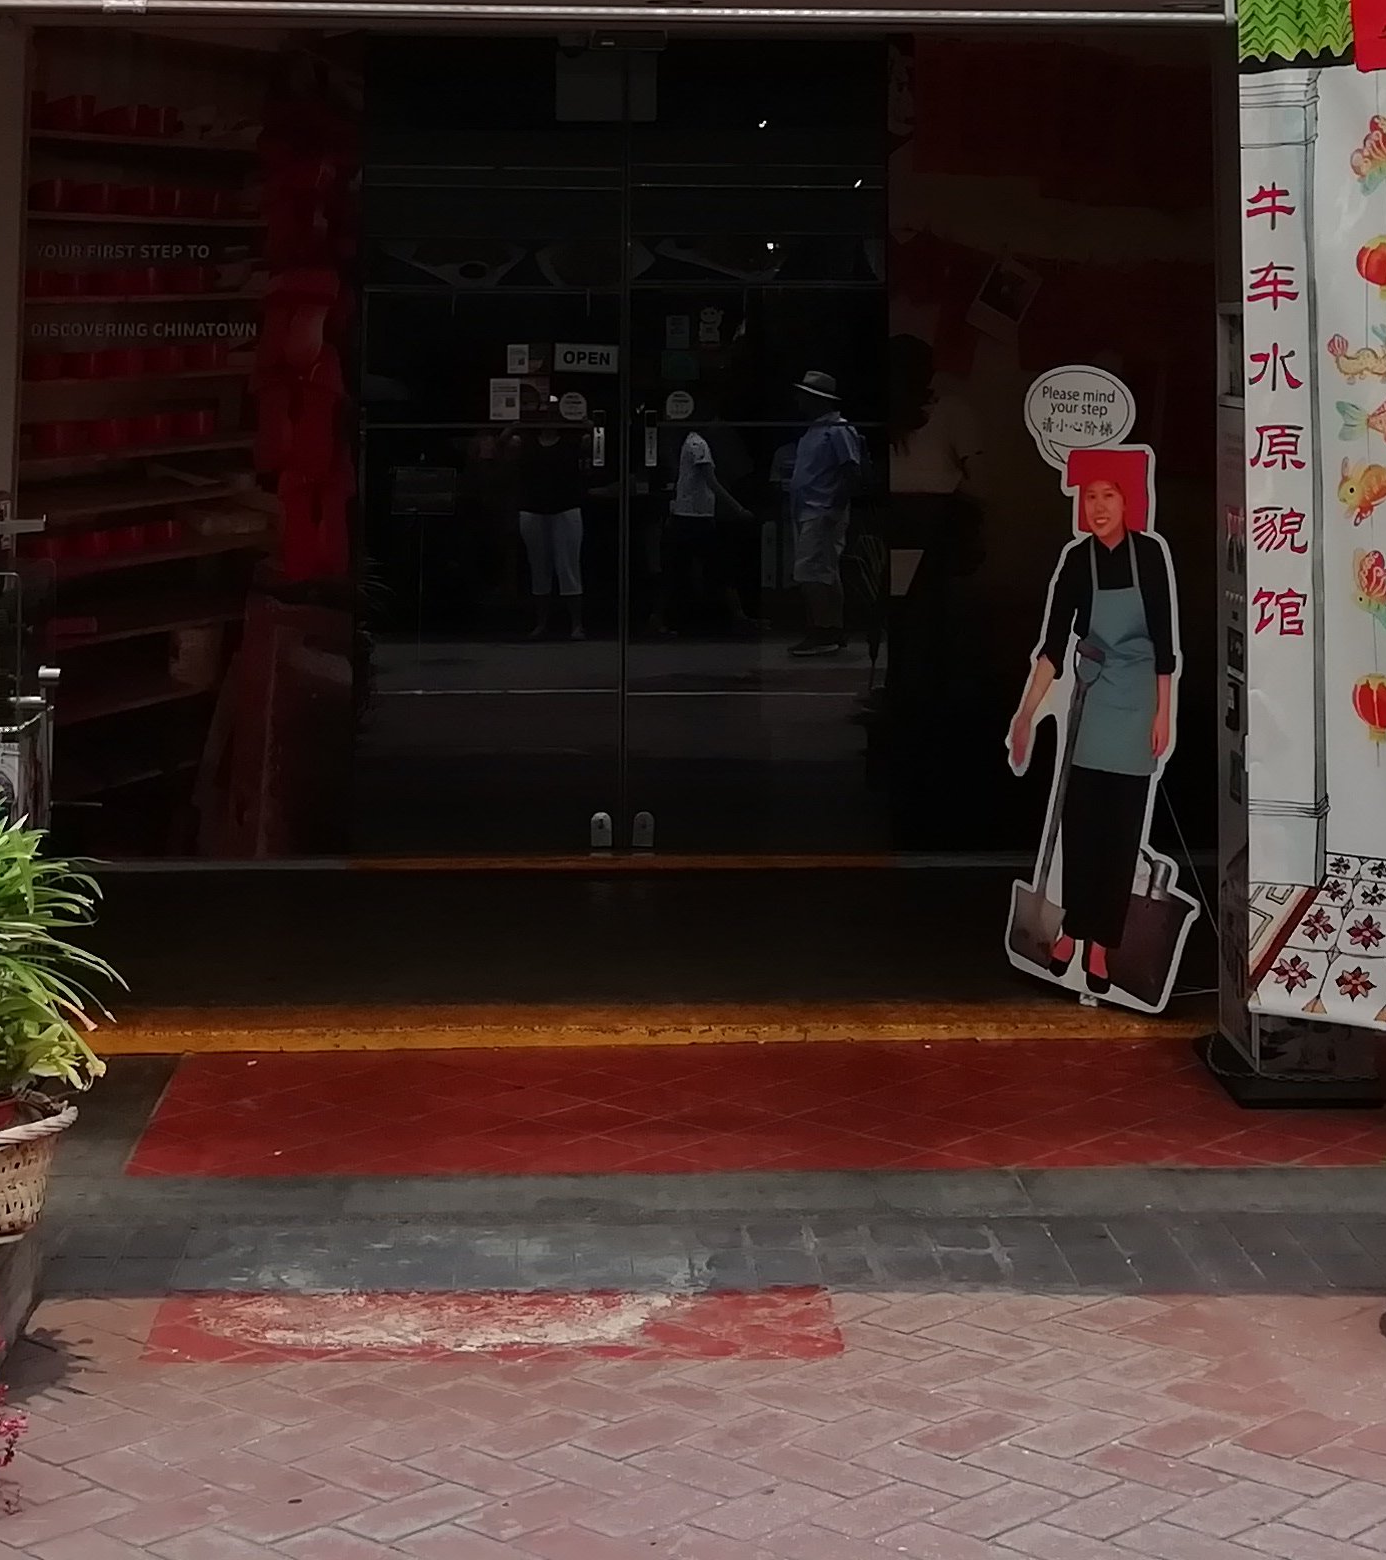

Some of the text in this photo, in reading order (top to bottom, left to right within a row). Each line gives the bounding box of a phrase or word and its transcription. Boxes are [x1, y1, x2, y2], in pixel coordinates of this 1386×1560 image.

[36, 244, 211, 260] YOUR FIRST STEP TO
[31, 321, 258, 338] DISCOVERING CHINATOWN
[563, 350, 610, 367] OPEN
[1042, 386, 1116, 403] Please mind
[1051, 402, 1108, 418] your step
[1245, 184, 1309, 638] 牛车水原貌馆
[1041, 418, 1113, 437] 请小心阶梯
